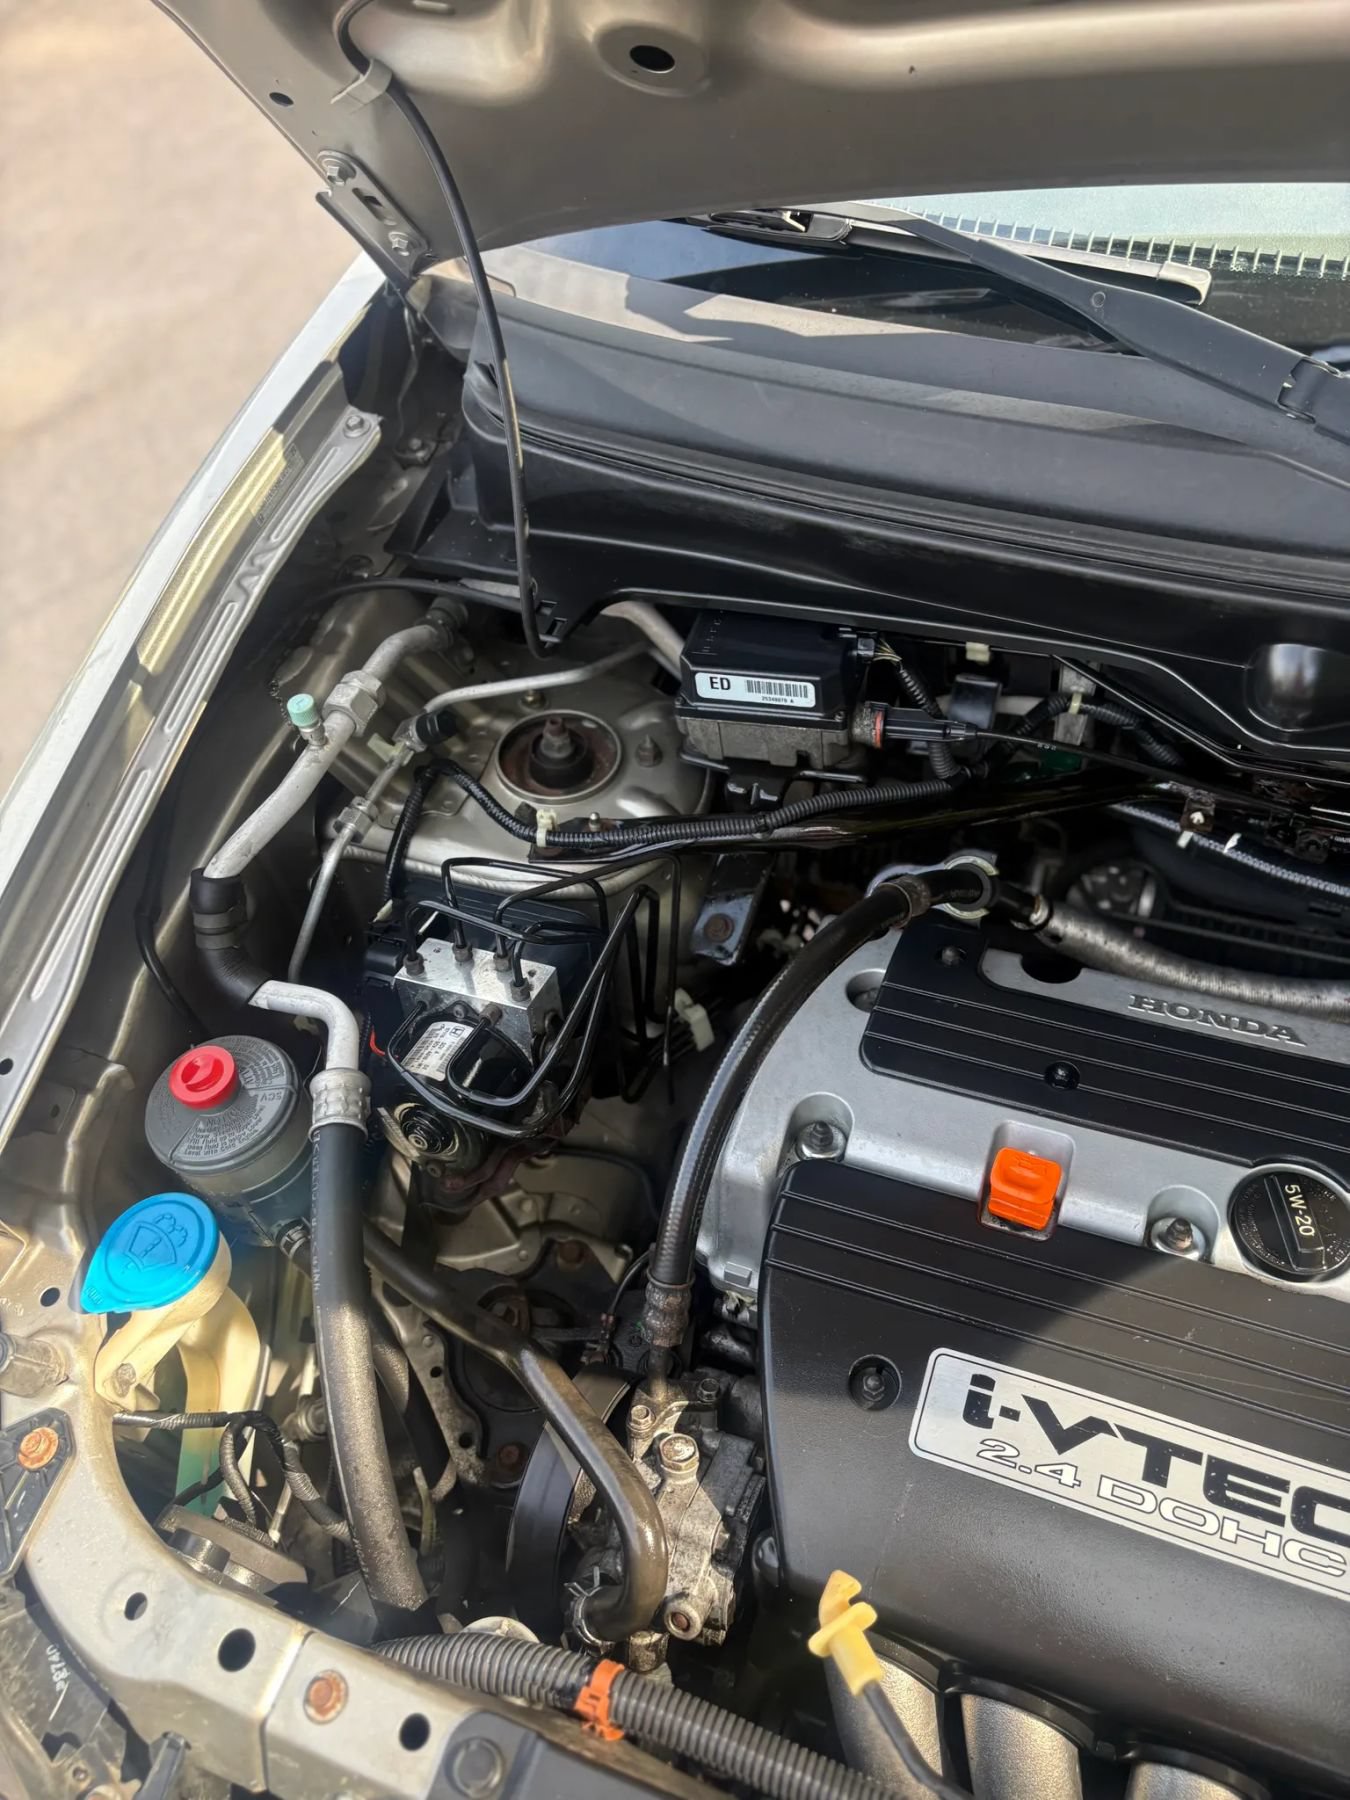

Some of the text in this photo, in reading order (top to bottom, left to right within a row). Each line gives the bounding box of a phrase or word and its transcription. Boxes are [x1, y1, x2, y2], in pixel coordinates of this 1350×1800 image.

[709, 676, 731, 691] ED
[1128, 993, 1308, 1047] HONDA
[1285, 1184, 1315, 1237] 5W-20
[976, 1438, 1347, 1578] 2.4 DOHC
